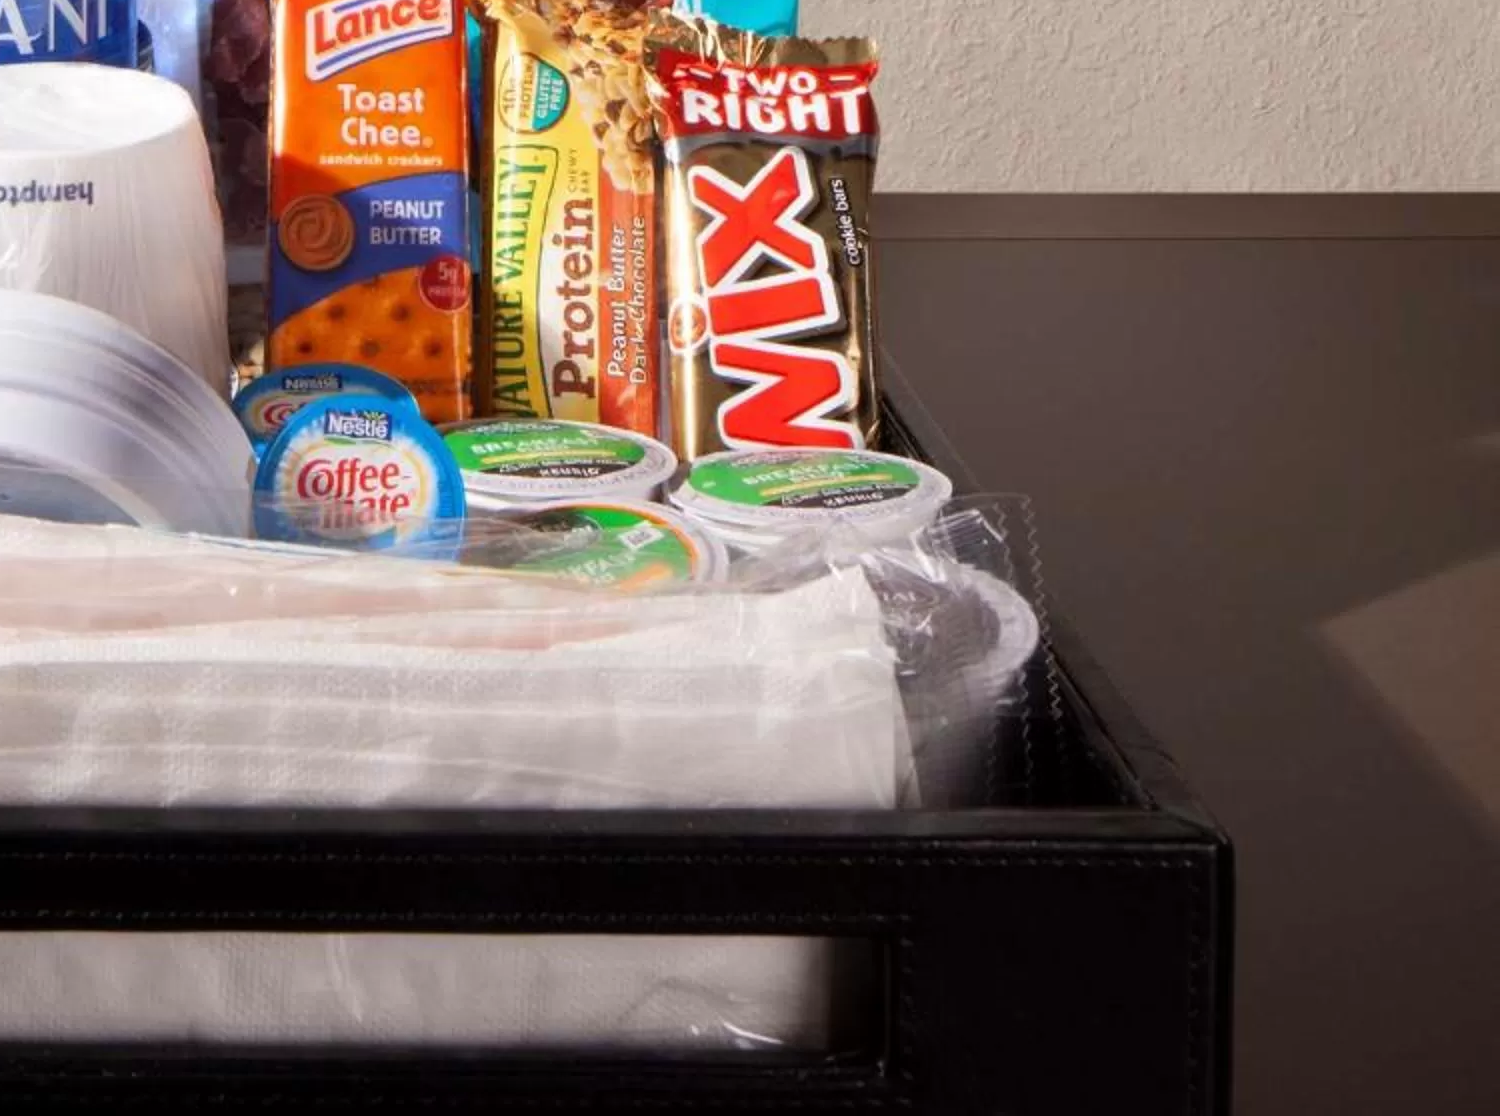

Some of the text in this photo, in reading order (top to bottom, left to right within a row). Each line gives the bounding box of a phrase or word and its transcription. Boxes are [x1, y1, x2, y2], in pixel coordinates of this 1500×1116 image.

[337, 83, 426, 114] Toast
[537, 67, 552, 119] GLUTEN
[550, 78, 565, 112] FREE
[721, 67, 818, 97] TWO
[682, 86, 868, 134] RIGHT
[319, 152, 444, 167] sandwich crackers
[567, 148, 578, 193] CHEWY
[370, 199, 445, 219] PEANUT
[493, 157, 547, 285] VALLEY
[831, 178, 861, 266] cookie bars
[370, 226, 442, 245] BUTTER
[552, 197, 595, 398] Protein
[607, 224, 628, 378] Peanut Butter
[688, 146, 861, 448] WIX
